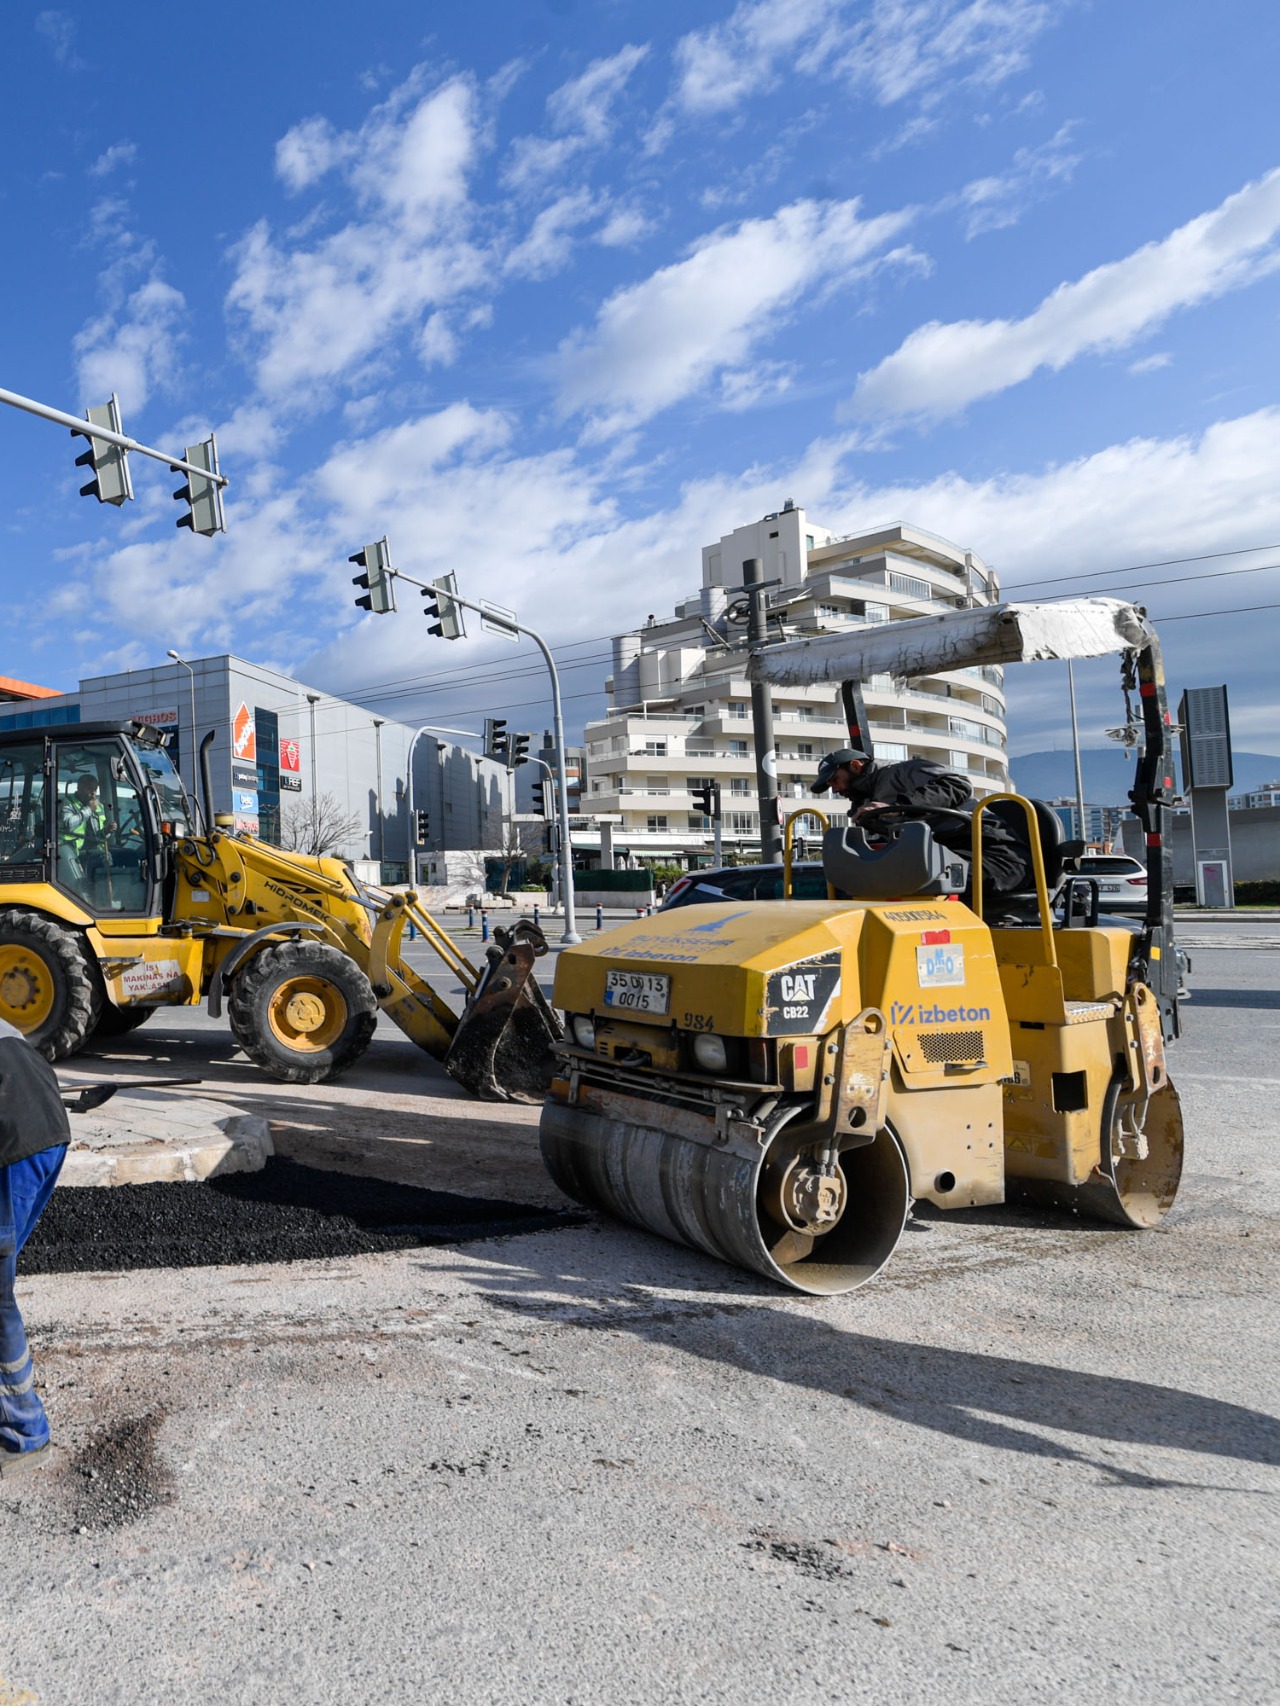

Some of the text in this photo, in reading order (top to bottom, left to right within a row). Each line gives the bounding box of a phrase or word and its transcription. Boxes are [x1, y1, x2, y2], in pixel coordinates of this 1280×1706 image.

[610, 973, 628, 987] 35
[648, 977, 664, 992] 13
[781, 974, 817, 1002] CAT
[619, 992, 650, 1009] 0015
[684, 1012, 715, 1031] 984
[783, 1006, 810, 1020] CB22
[919, 1004, 991, 1024] izbeton
